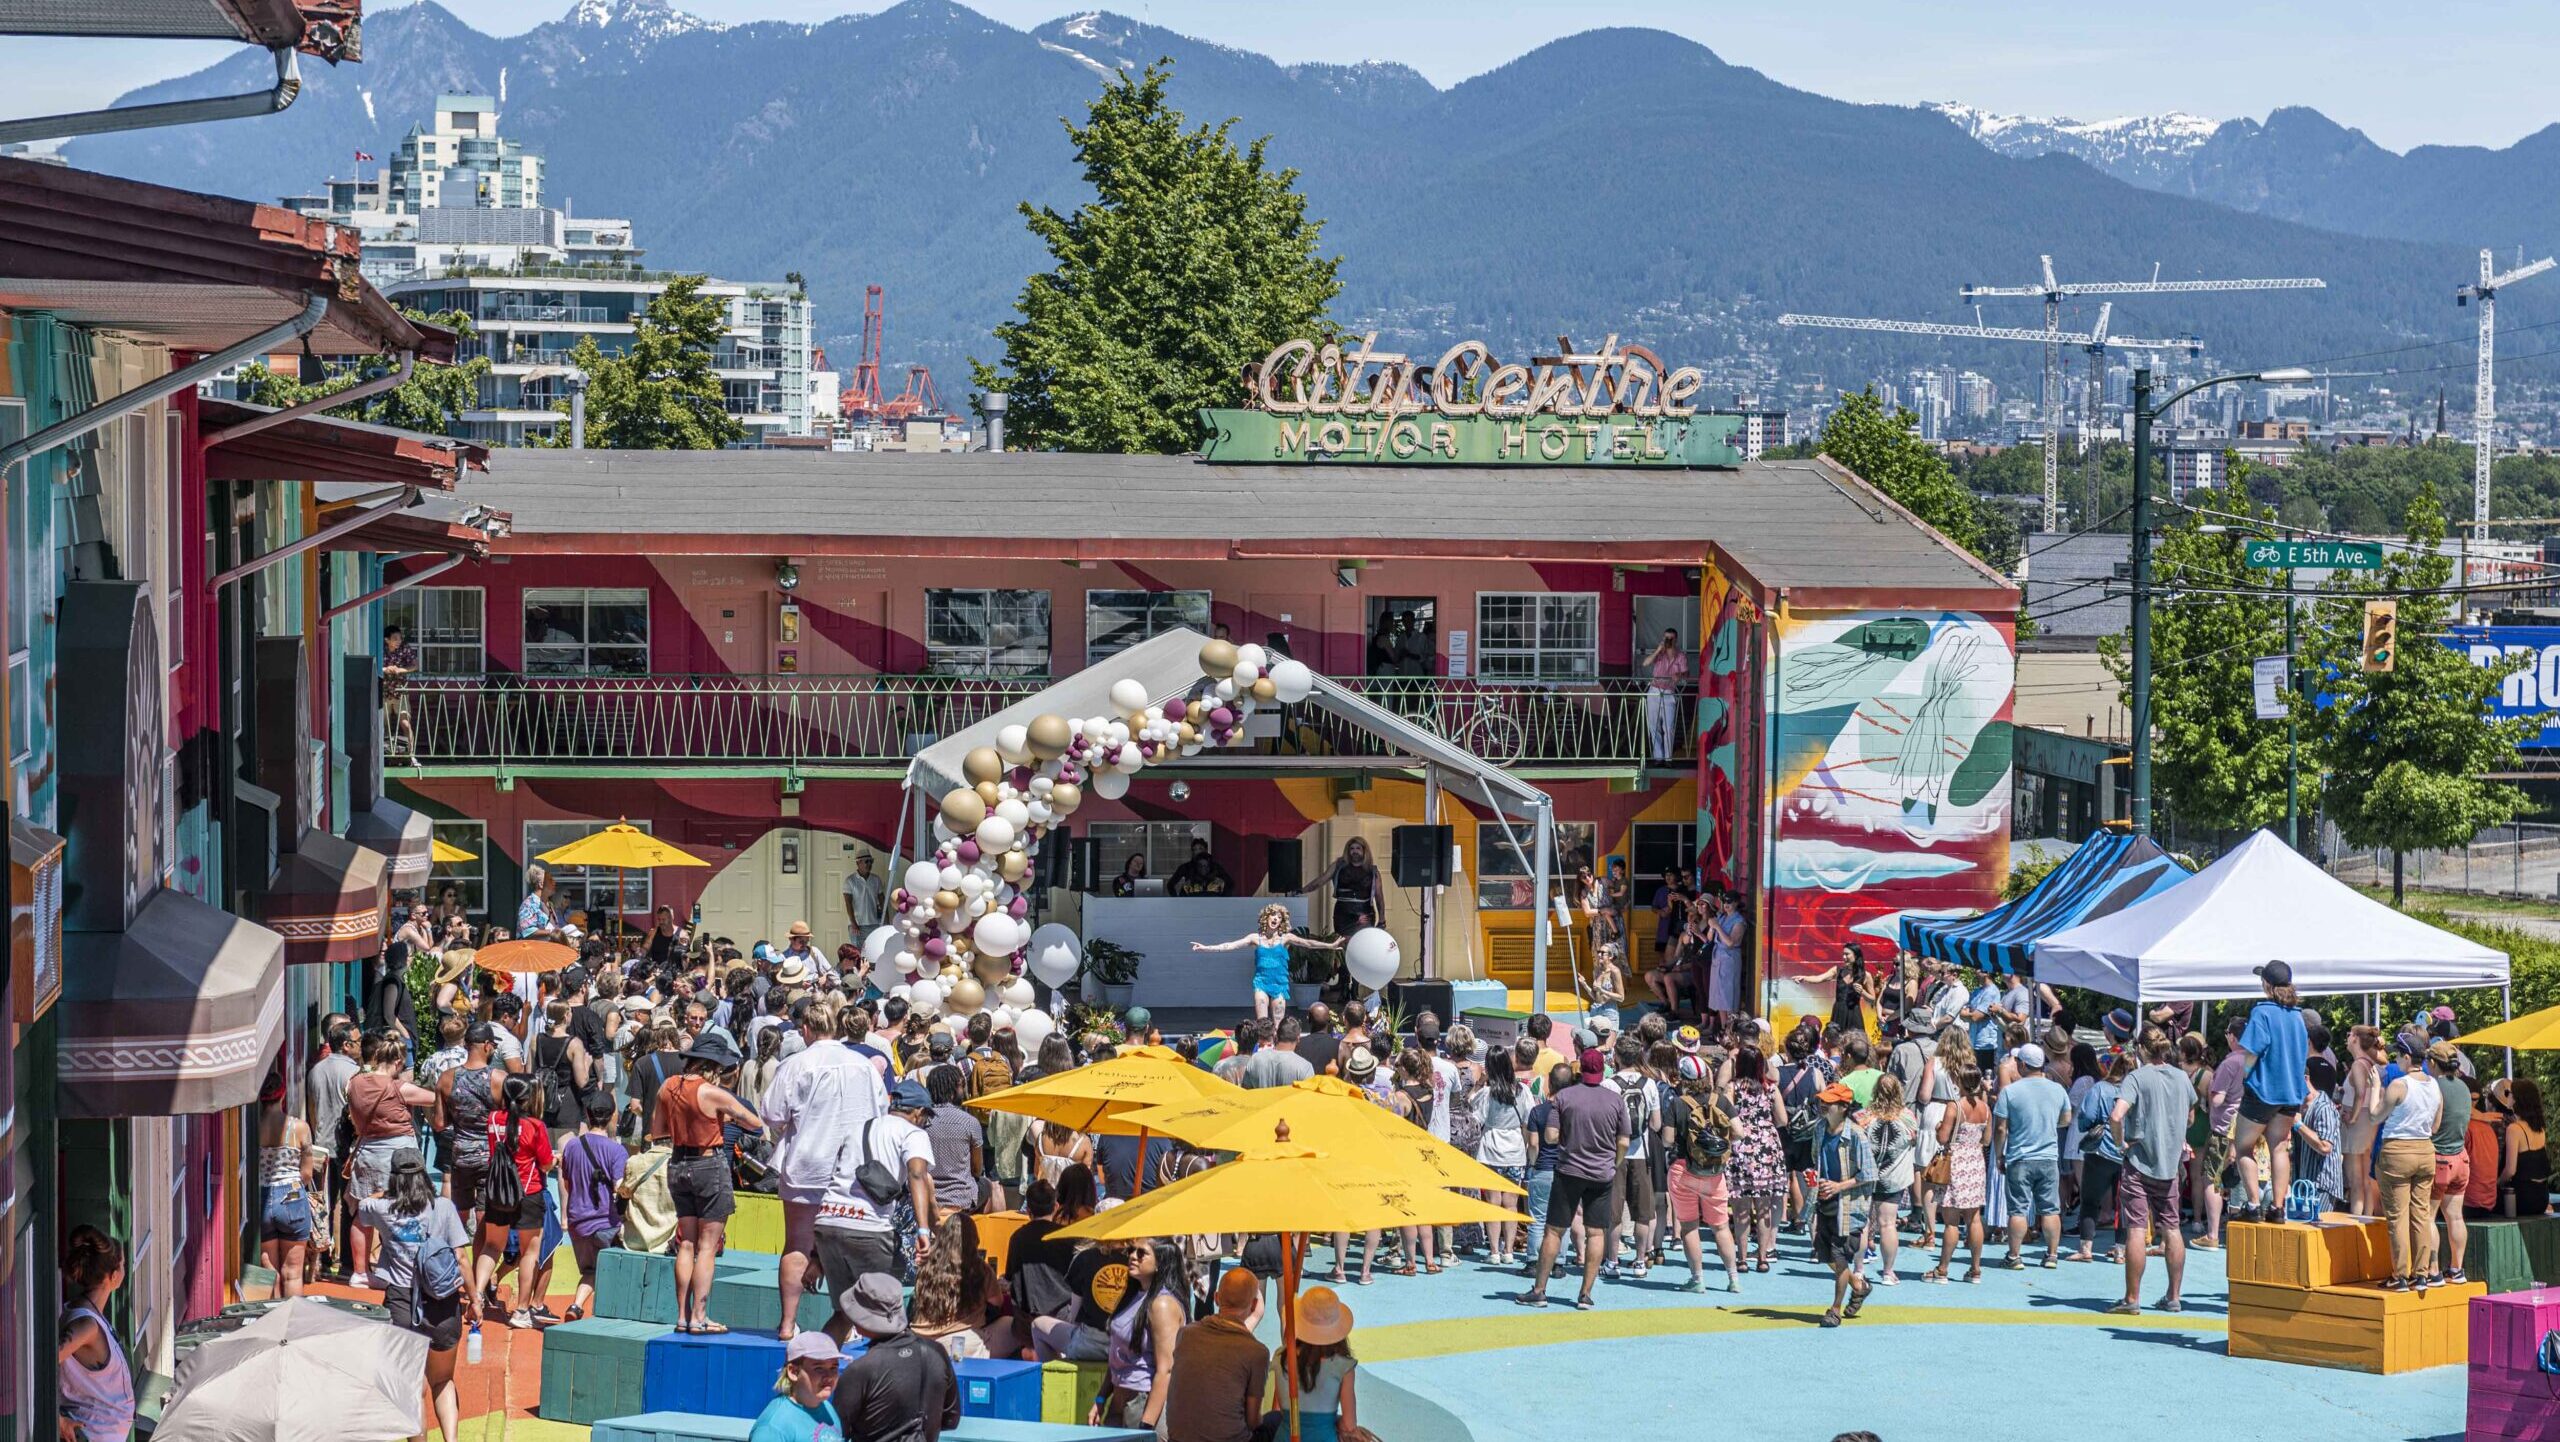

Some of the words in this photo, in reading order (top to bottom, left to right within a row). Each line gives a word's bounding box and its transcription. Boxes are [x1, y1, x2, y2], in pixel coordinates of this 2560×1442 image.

[1259, 331, 1424, 457] City
[1432, 333, 1700, 416] Centre
[1279, 421, 1458, 457] MOTOR
[1502, 422, 1666, 458] HOTEL
[2288, 547, 2297, 562] E
[2303, 548, 2328, 563] 5th
[2335, 548, 2367, 564] Ave.
